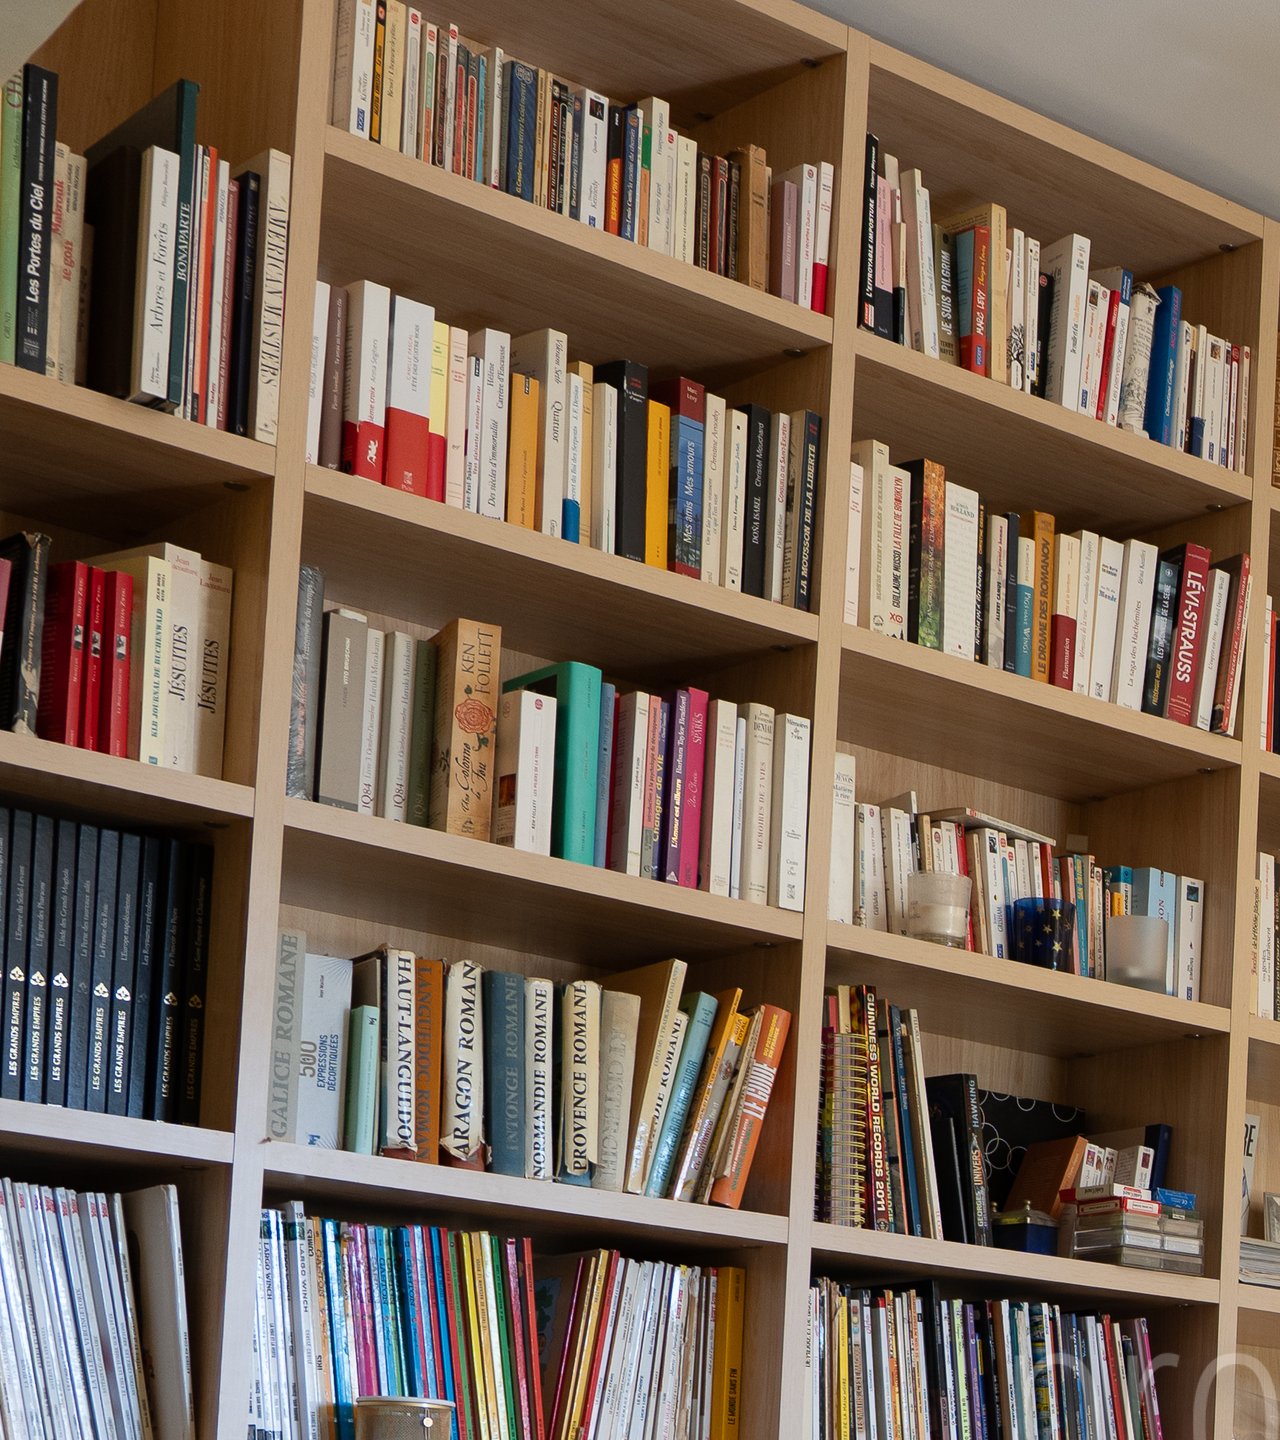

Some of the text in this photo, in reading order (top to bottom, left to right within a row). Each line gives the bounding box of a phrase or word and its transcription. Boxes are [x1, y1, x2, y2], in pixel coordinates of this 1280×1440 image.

[26, 183, 45, 303] Les Portes du Ciel
[148, 222, 170, 335] Arbres et Forêts
[176, 202, 191, 282] BONAPARTE
[866, 198, 876, 297] L'EFFROYABLE IMPOSTURE
[260, 204, 288, 387] AMERICAN MASTERS
[940, 250, 952, 335] JE SUIS PILGRIM
[975, 289, 986, 336] MARC LEVY
[487, 362, 496, 387] Hélène
[552, 401, 563, 442] Quatuor
[754, 422, 765, 487] Christel Mouchard
[488, 419, 500, 507] Des siècles d'immortalité
[684, 442, 696, 543] Mes amis Mes amours
[753, 496, 762, 520] ISABEL
[800, 491, 814, 596] LA MOUSSON DE LA
[891, 476, 903, 608] GUILLAUME MUSSO FILLE BROOKLYN
[1038, 538, 1050, 674] LE DRAME DES ROMANOV
[1130, 600, 1142, 644] Hachémites
[1176, 570, 1206, 682] LÉVI-STRAUSS
[168, 624, 188, 701] JÉSUITES
[196, 638, 220, 714] JÉSUITES
[461, 643, 475, 674] KEN
[476, 628, 494, 694] FOLLETT
[1062, 637, 1070, 680] Flammarion
[1129, 660, 1137, 677] saga
[151, 680, 160, 719] JOURNAL
[360, 638, 381, 810] 1Q84 Haruki Murakami
[392, 640, 412, 810] 1Q84 Haruki Murakami
[692, 712, 704, 745] SPARKS
[676, 748, 684, 774] Barbara
[652, 776, 662, 842] Changer de
[671, 778, 682, 848] L'Amour ailleurs
[8, 991, 22, 1075] LES GRANDS EMPIRES
[30, 996, 43, 1080] LES GRANDS EMPIRES
[52, 997, 64, 1081] LES GRANDS EMPIRES
[91, 1007, 105, 1090] LES GRANDS EMPIRES
[113, 1010, 127, 1092] LES GRANDS EMPIRES
[161, 1016, 174, 1097] LES GRANDS EMPIRES
[272, 934, 299, 1138] GALICE ROMANE
[504, 976, 519, 1059] ROMANE
[299, 1040, 316, 1078] 500
[316, 1034, 328, 1088] EXPRESSIONS
[326, 1034, 339, 1092] DÉCORTIQUÉES
[415, 967, 432, 1160] LANGUEDOC ROMAN
[453, 962, 477, 1156] ARAGON ROMAN
[532, 988, 547, 1179] NORMANDIE ROMANE
[572, 982, 588, 1172] PROVENCE ROMANE
[742, 1061, 778, 1120] LE GUIDE
[866, 992, 885, 1210] GUINNESS WORLD RECORDS 2011
[968, 1080, 980, 1128] HAWKING
[971, 1150, 984, 1186] UNIVERS
[306, 1228, 314, 1257] COMES
[728, 1368, 738, 1416] MONDE SANS FIN
